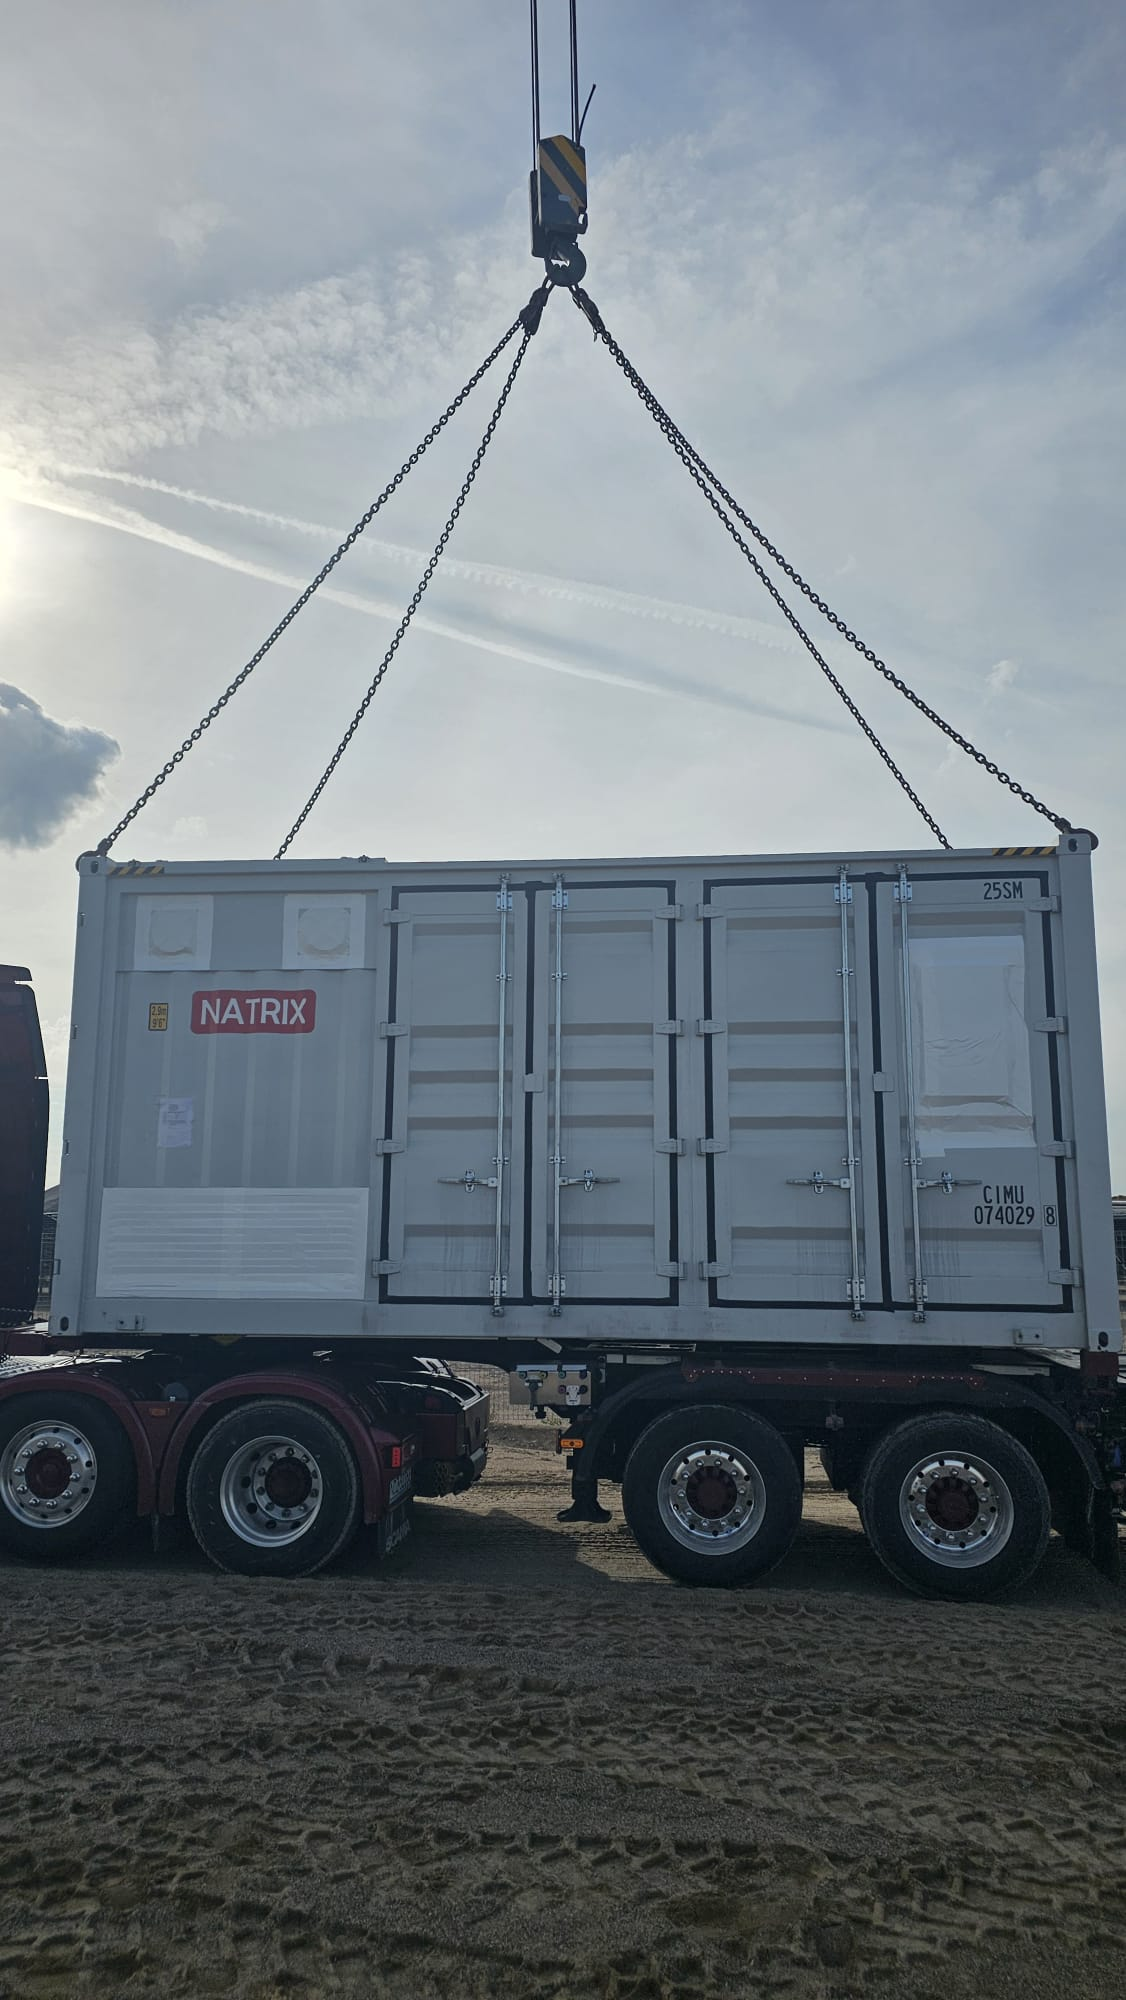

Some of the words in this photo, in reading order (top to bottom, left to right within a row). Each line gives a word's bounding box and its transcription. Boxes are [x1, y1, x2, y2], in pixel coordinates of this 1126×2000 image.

[983, 881, 1023, 900] 25SM
[200, 998, 307, 1025] NATRIX
[983, 1185, 1024, 1204] CIMU
[974, 1205, 1035, 1225] 074029
[1046, 1206, 1055, 1225] 8
